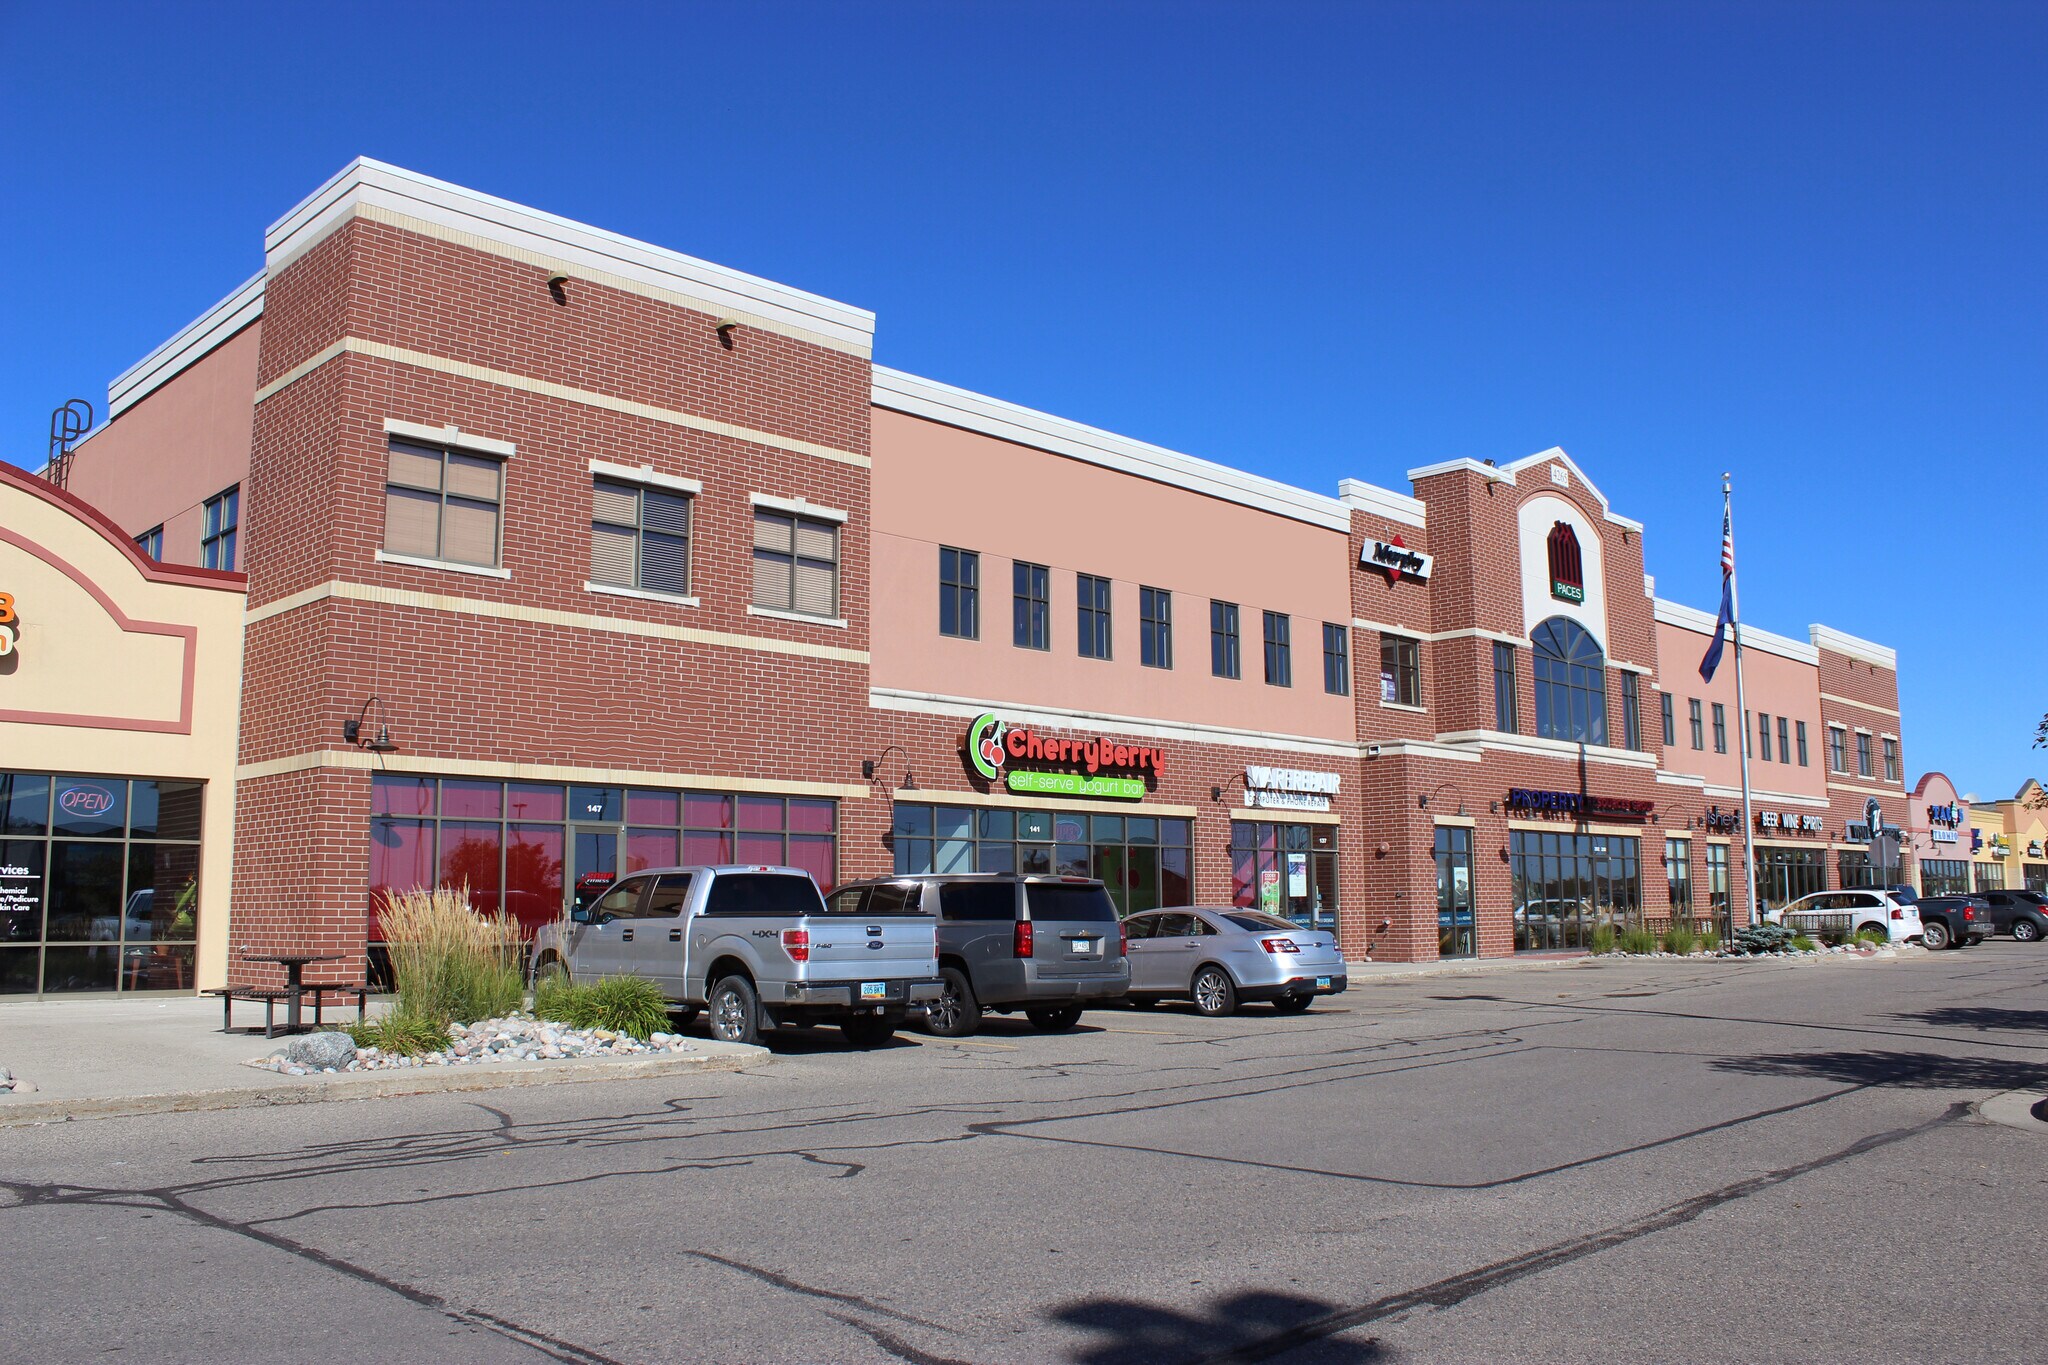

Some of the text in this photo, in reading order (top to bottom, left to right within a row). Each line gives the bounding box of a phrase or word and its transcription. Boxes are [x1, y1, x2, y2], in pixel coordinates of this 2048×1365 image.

[1373, 542, 1424, 574] Murphy
[1557, 583, 1582, 599] PACES
[1007, 729, 1165, 777] CherryBerry
[1009, 774, 1143, 795] self-serve yogurt bar
[62, 791, 110, 809] OPEN
[587, 804, 602, 812] 147
[1512, 788, 1582, 810] PROPERTY
[1762, 811, 1823, 831] BEER WINE SPIRITS
[0, 864, 29, 875] vices
[12, 903, 30, 911] Care
